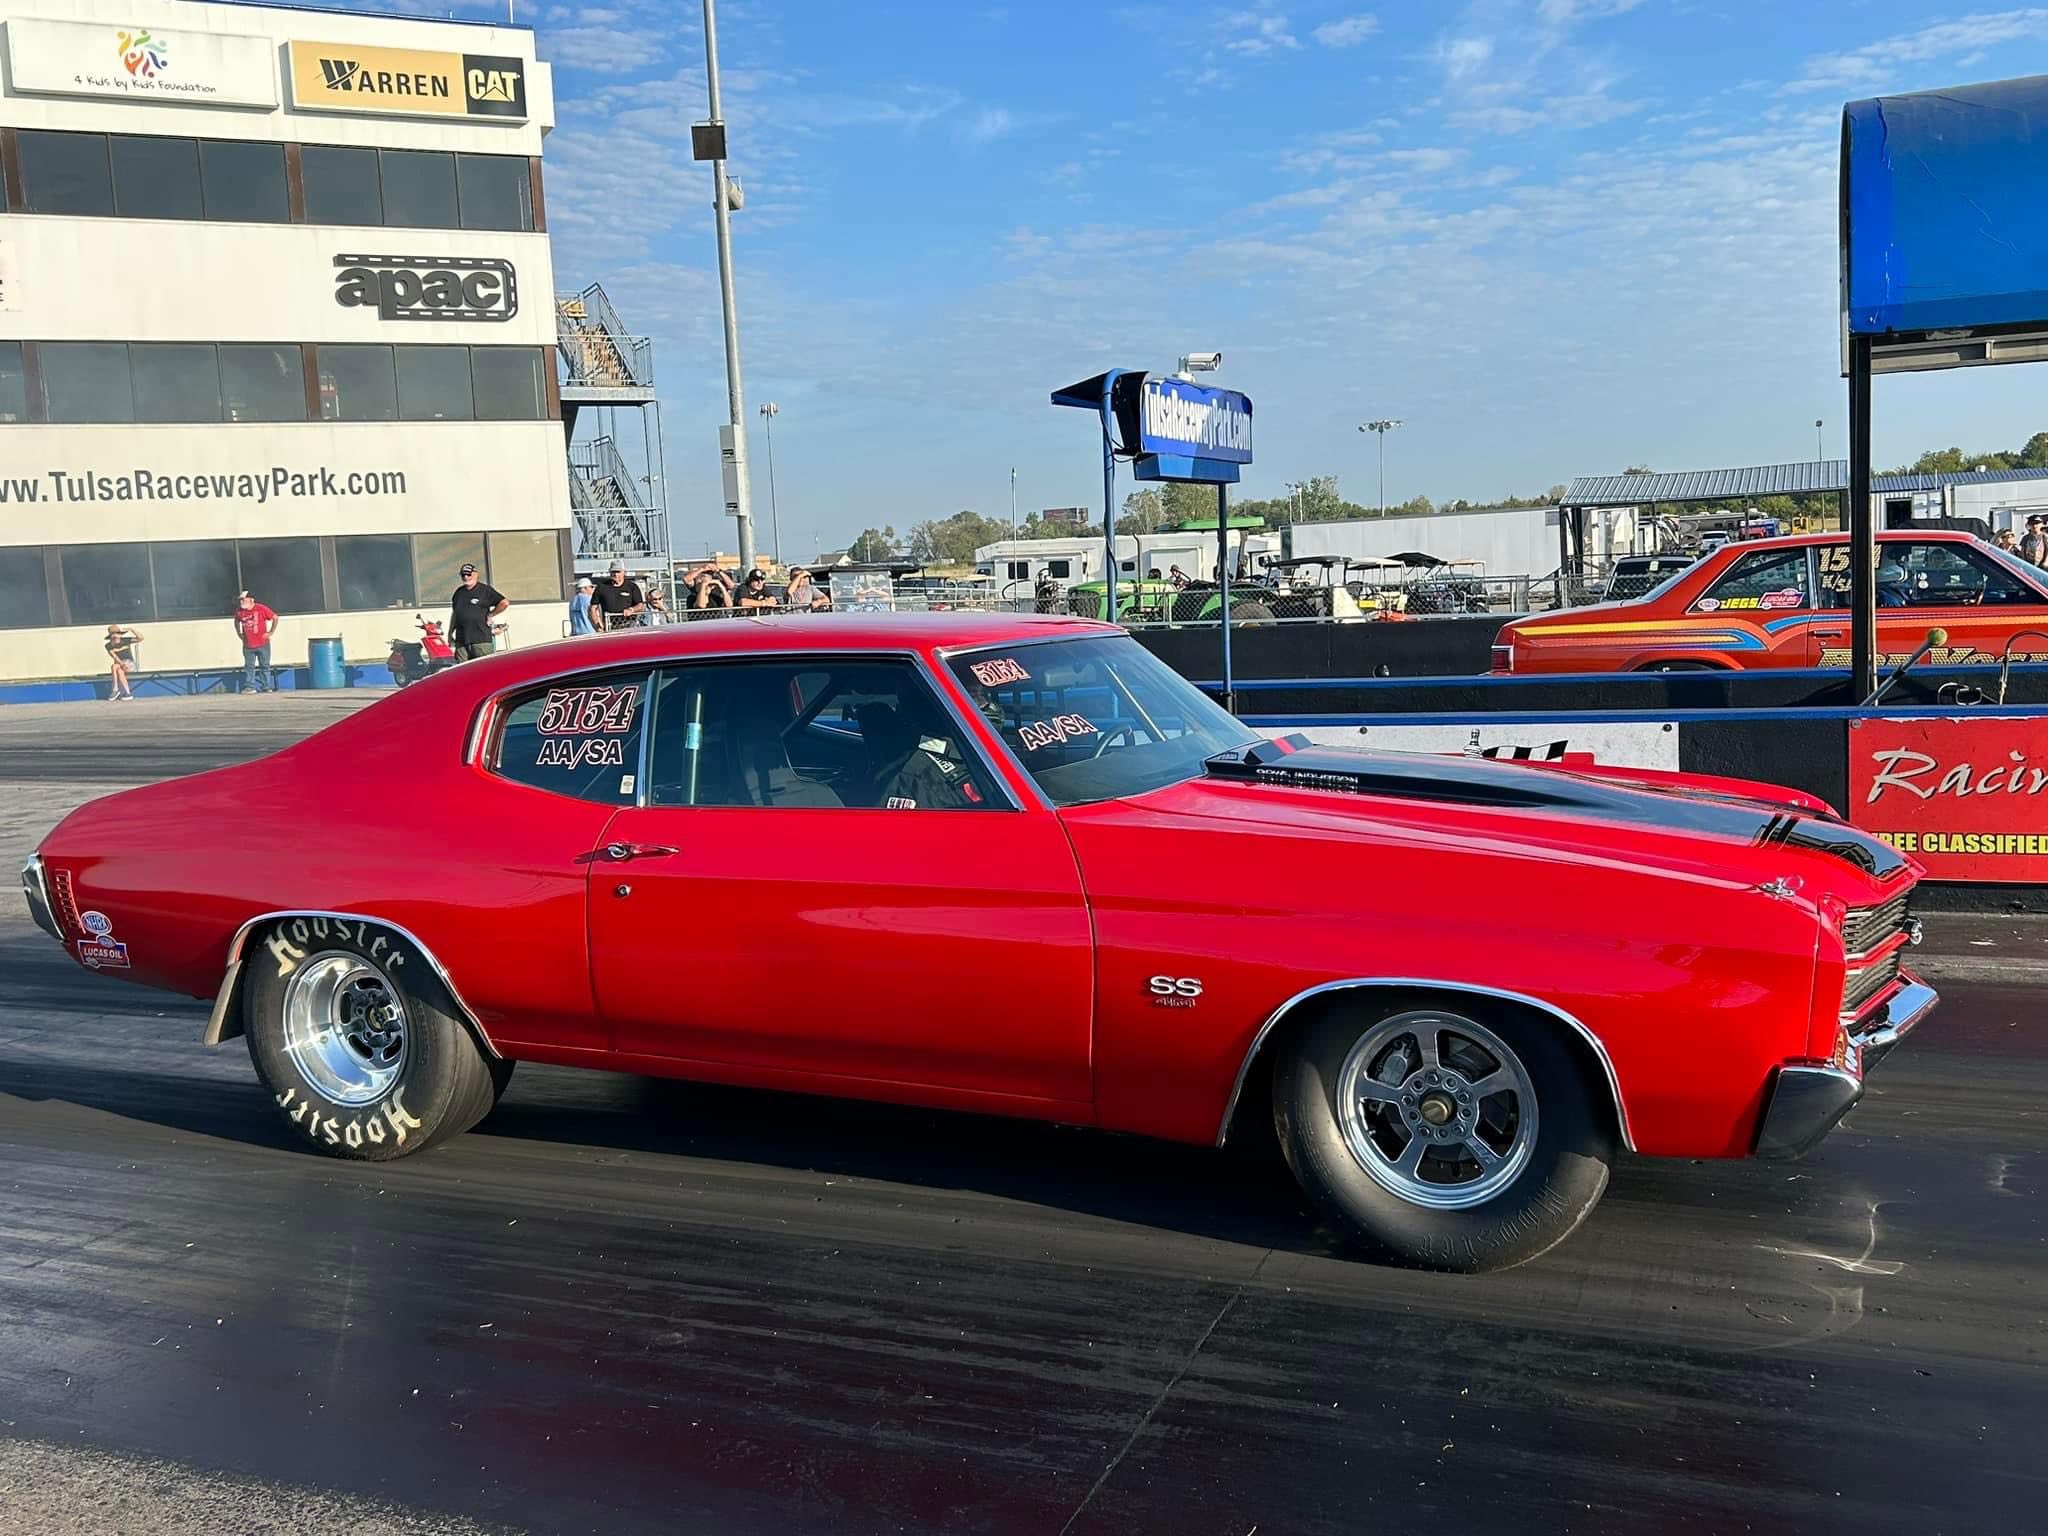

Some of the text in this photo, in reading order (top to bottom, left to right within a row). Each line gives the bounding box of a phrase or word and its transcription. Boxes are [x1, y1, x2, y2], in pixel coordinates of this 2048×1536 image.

[74, 75, 216, 93] 4 Kids by Kids Foundation
[319, 58, 521, 102] WARREN CAT
[335, 267, 502, 321] apac
[970, 658, 1031, 687] 5154
[537, 686, 639, 735] 5154
[1018, 714, 1098, 751] AA/SA
[536, 739, 623, 770] AA/SA
[1873, 833, 1917, 852] REE
[84, 947, 123, 959] LUCAS OIL
[265, 917, 404, 978] Hoosier
[1150, 975, 1203, 997] SS
